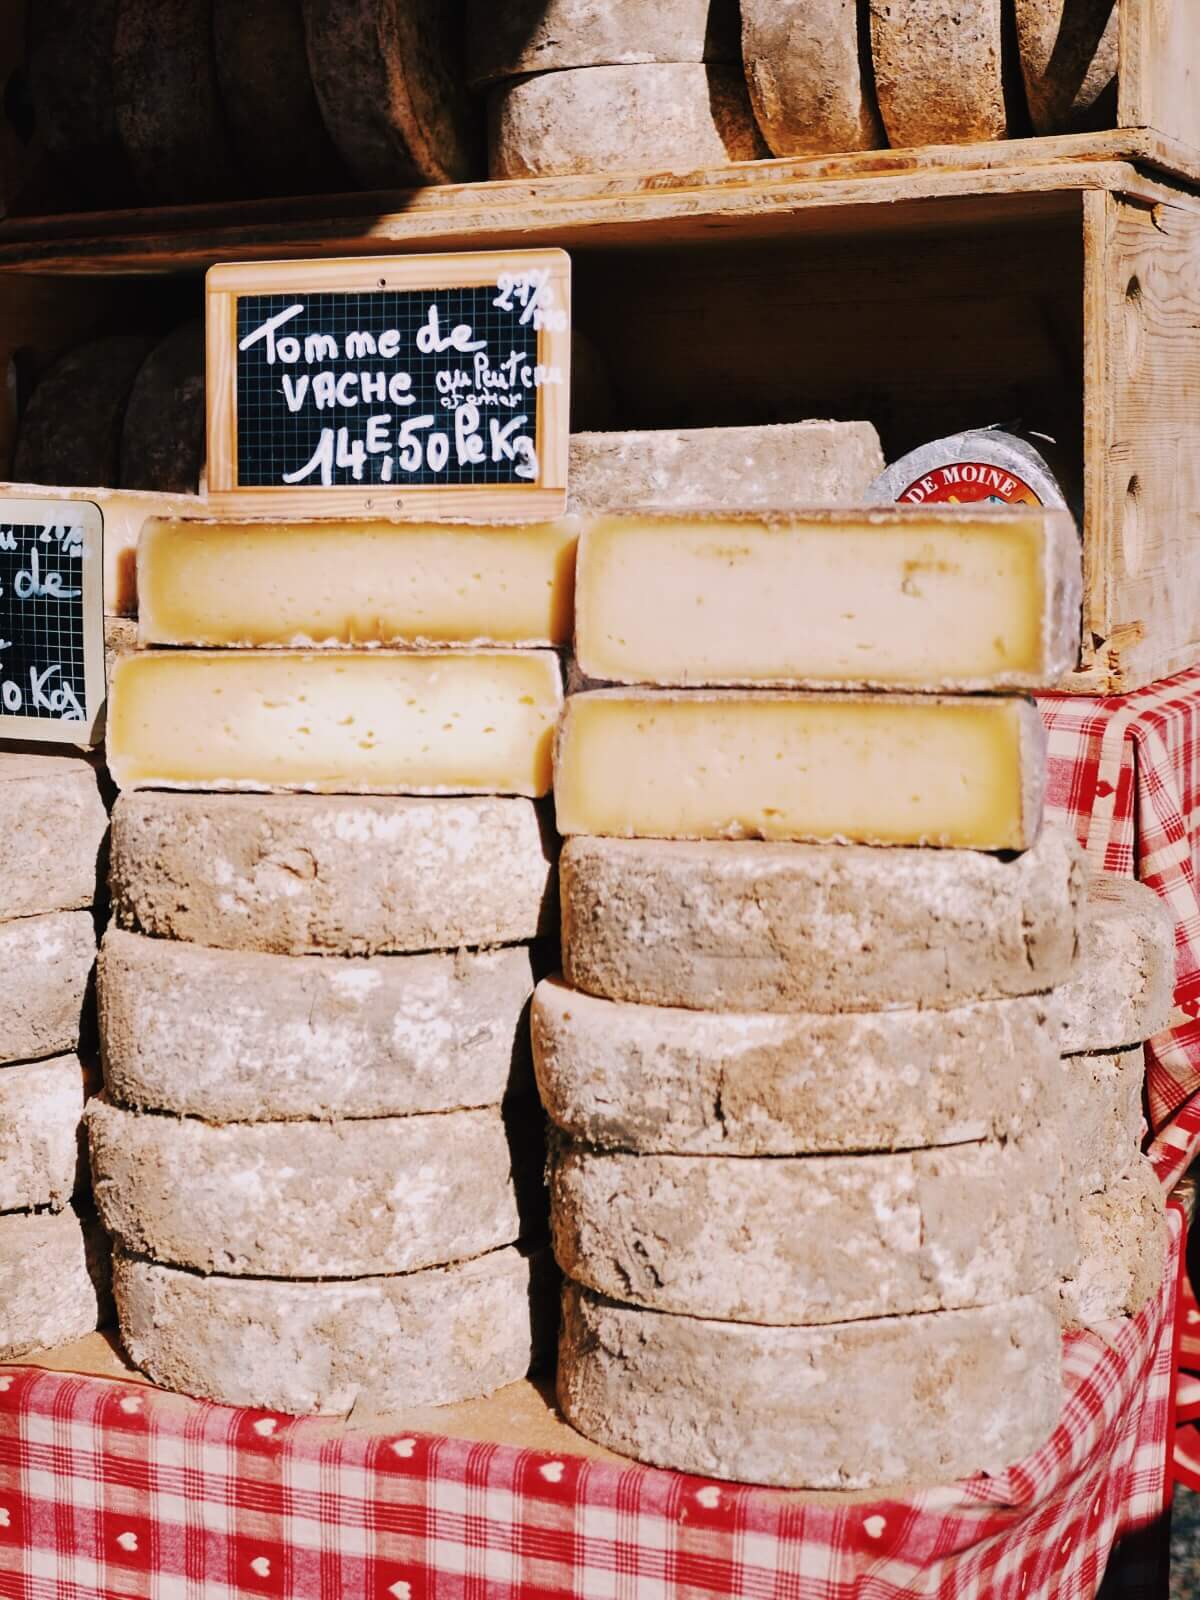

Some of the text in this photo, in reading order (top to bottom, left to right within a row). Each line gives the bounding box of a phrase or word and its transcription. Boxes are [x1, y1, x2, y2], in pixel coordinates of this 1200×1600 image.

[239, 303, 487, 364] Tomme de
[436, 369, 472, 394] au
[490, 415, 539, 479] Kg
[905, 465, 1017, 504] DE MOINE
[14, 547, 81, 599] de
[30, 665, 87, 721] Kg
